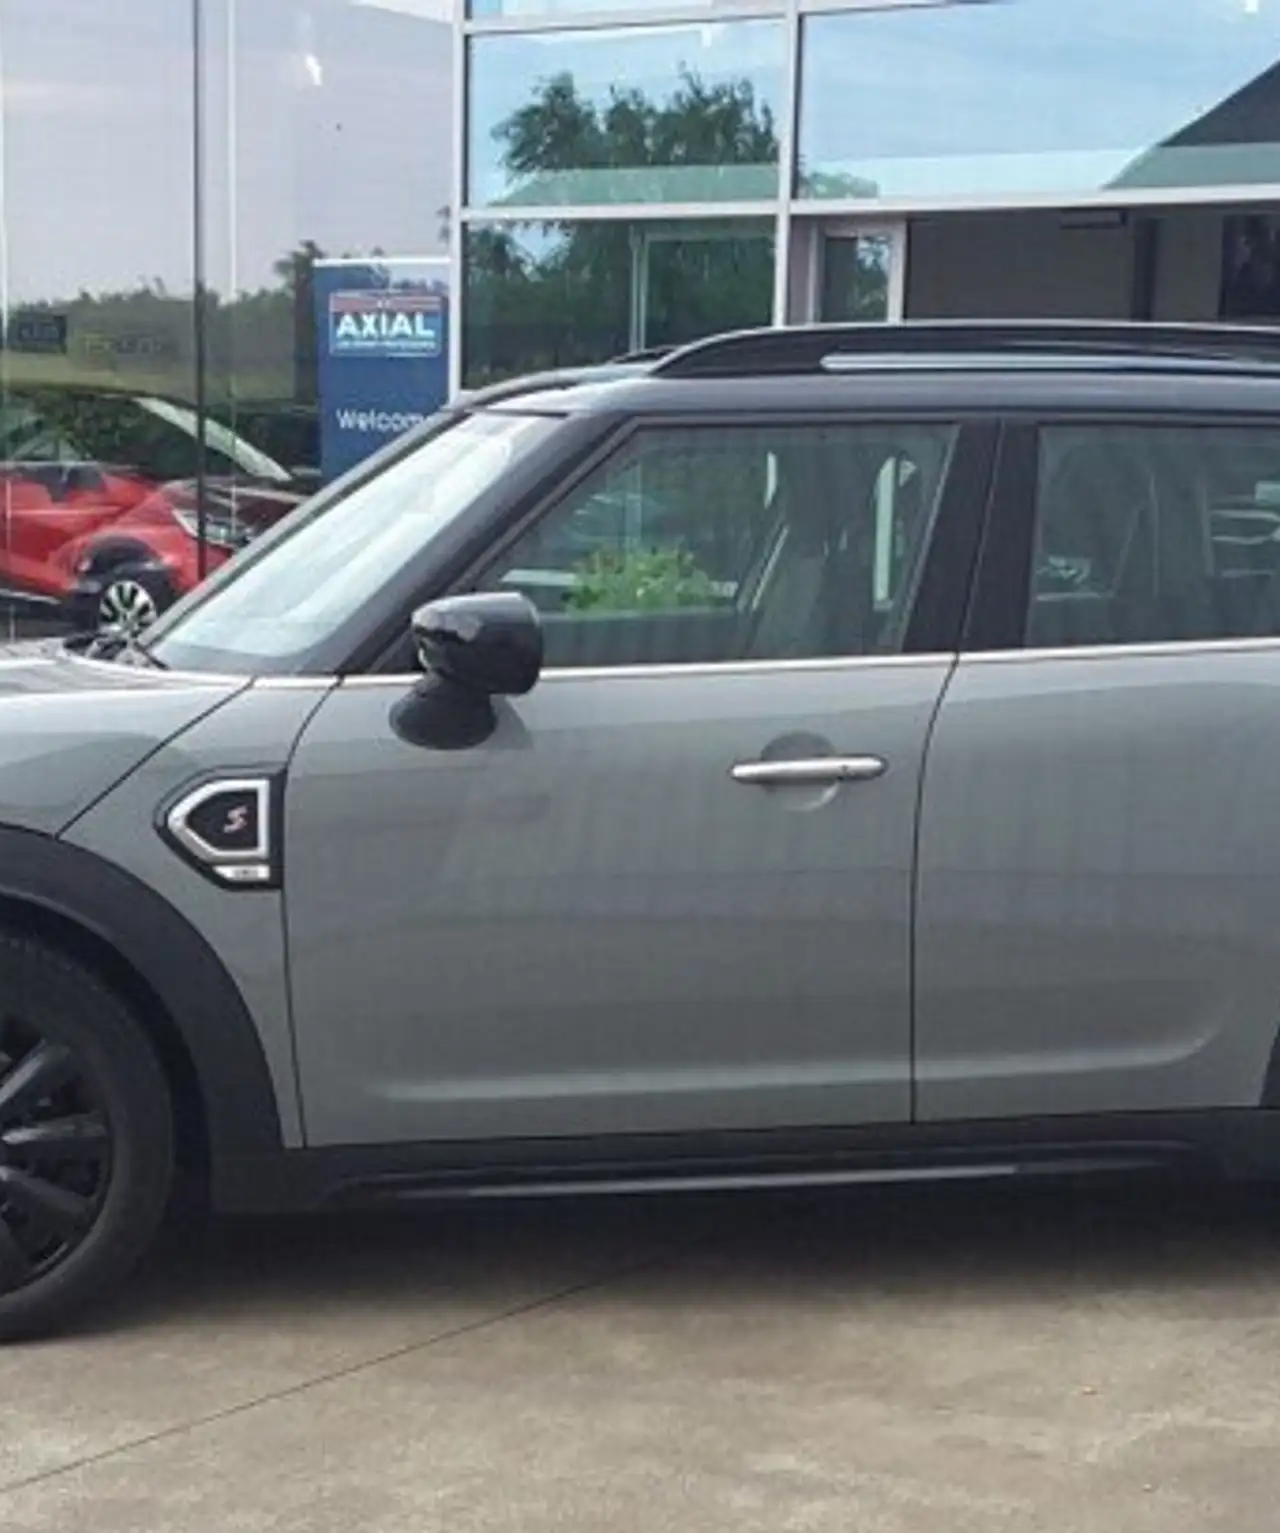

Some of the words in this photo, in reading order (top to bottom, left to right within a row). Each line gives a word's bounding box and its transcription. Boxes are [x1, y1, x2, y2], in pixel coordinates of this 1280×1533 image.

[336, 311, 435, 338] AXIAL
[336, 408, 424, 432] Welcom
[223, 805, 248, 833] S
